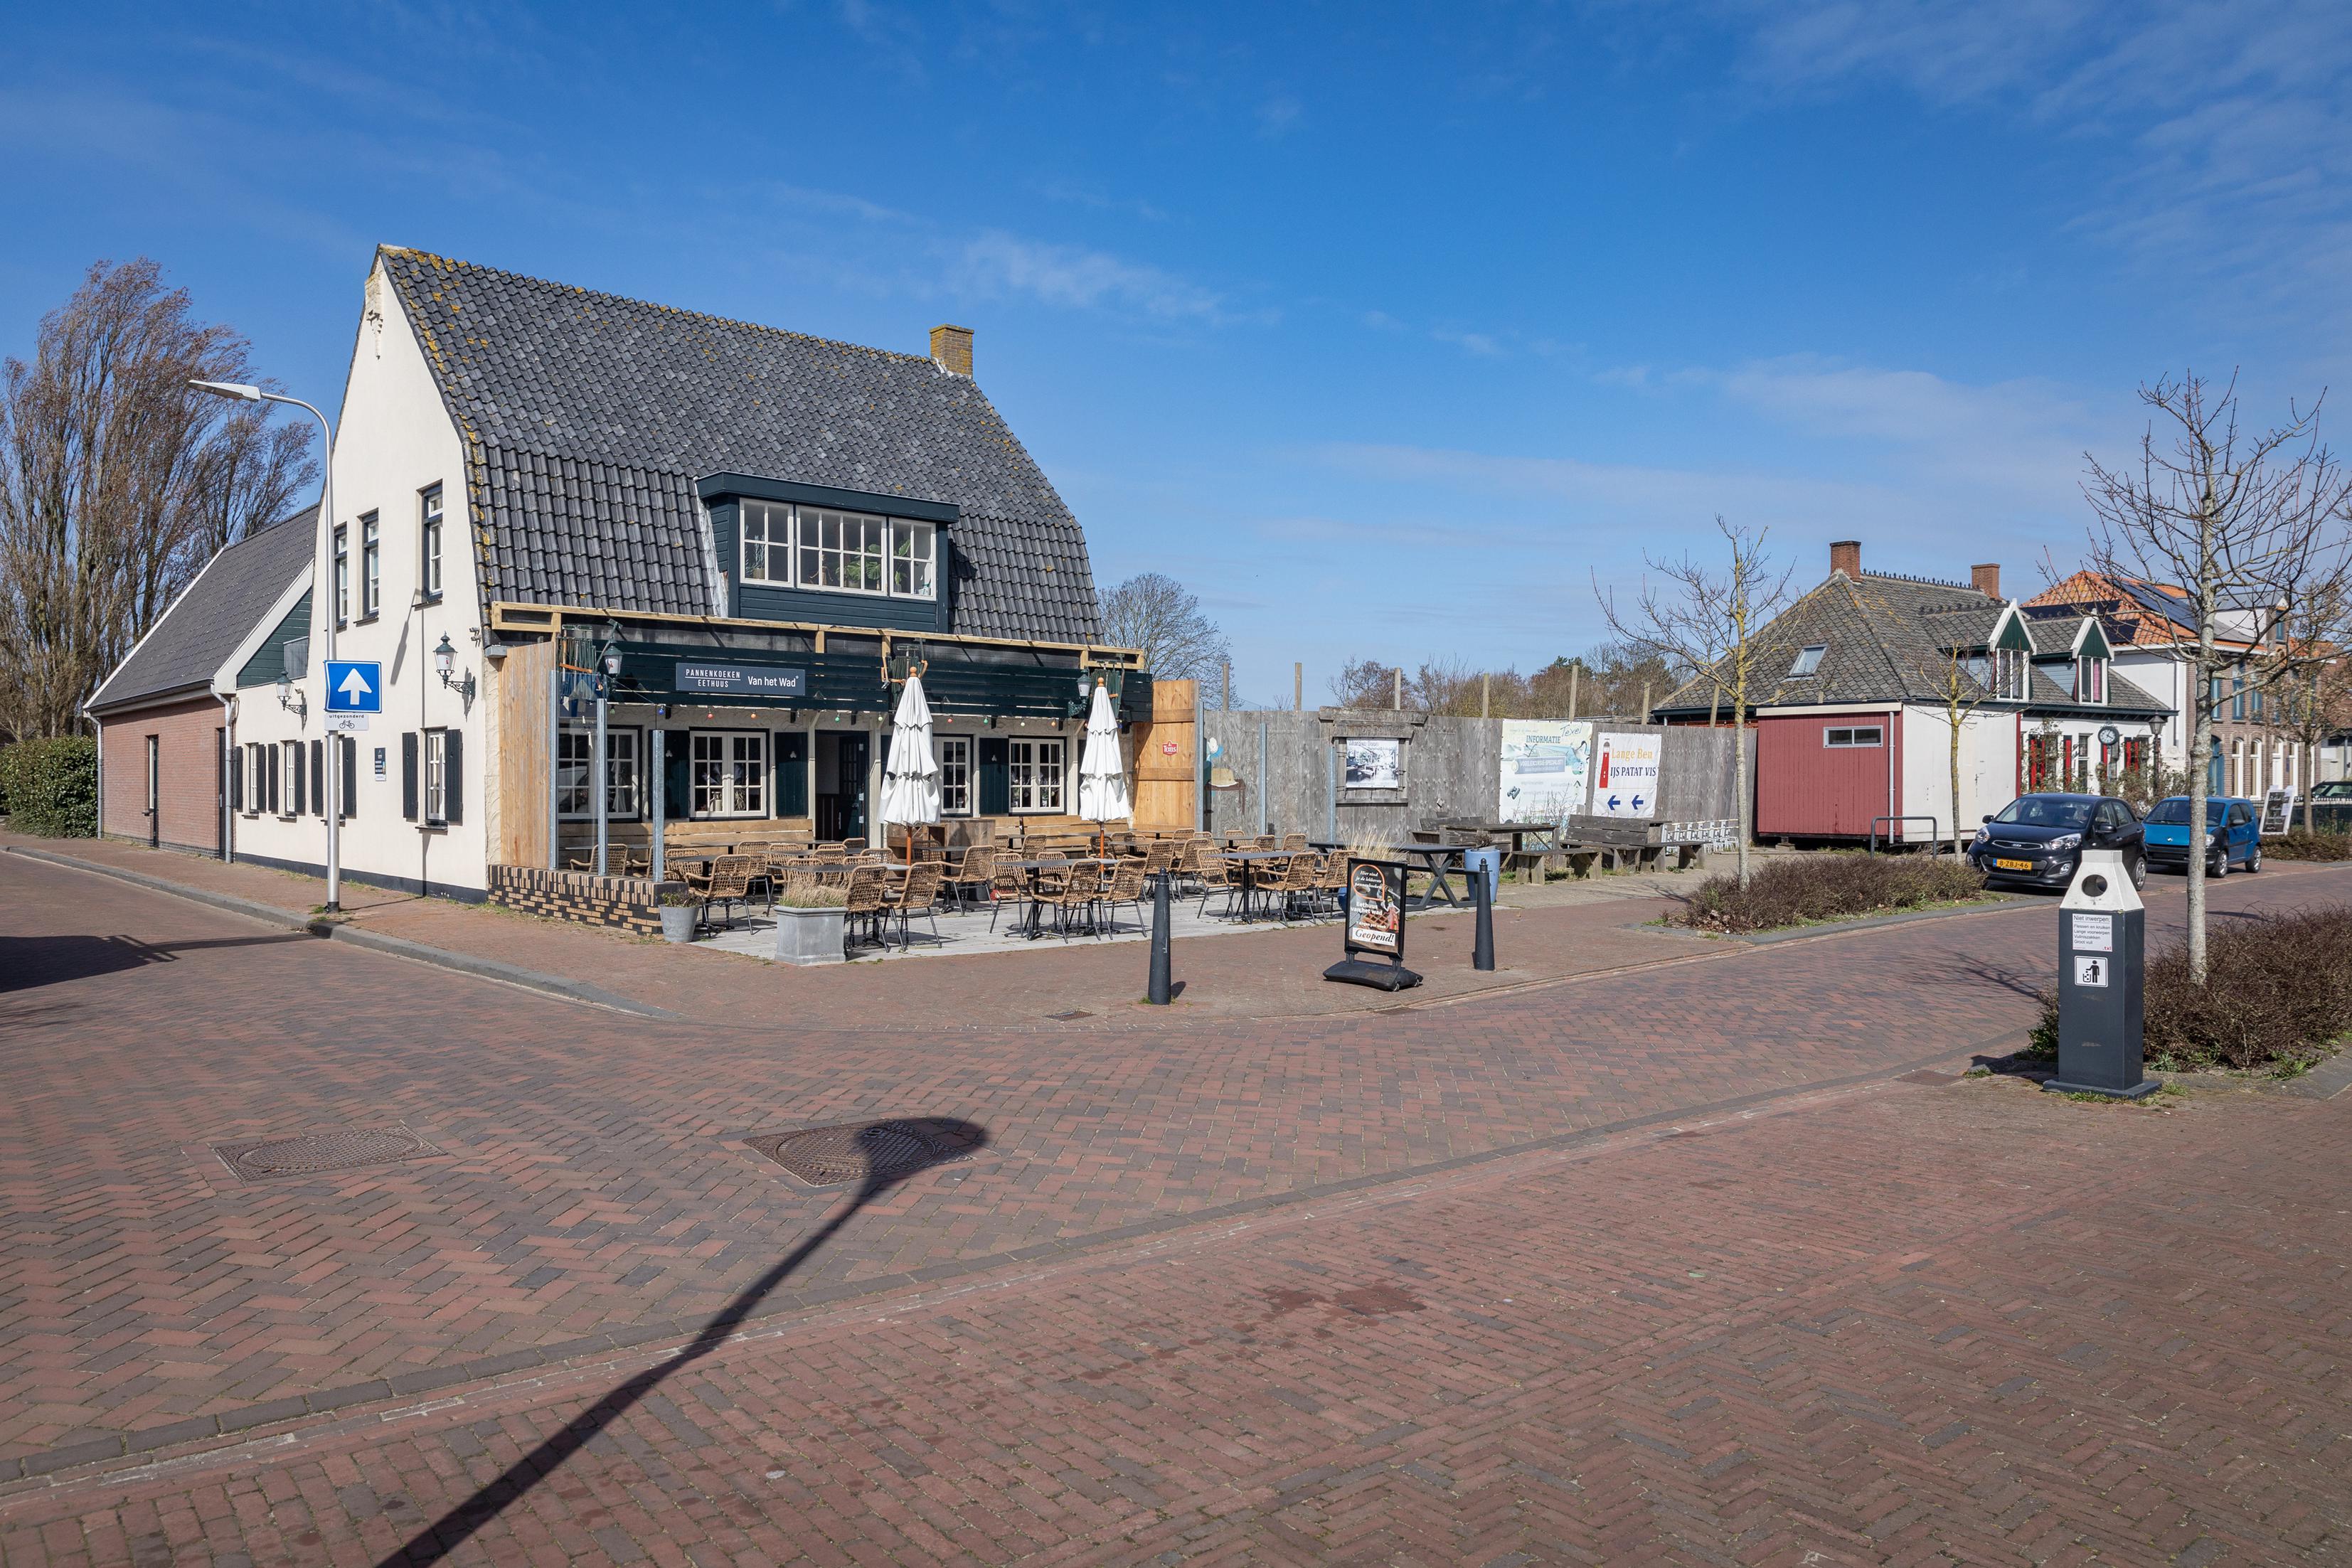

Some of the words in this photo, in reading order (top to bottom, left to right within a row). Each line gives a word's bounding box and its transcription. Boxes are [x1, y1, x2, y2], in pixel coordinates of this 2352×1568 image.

[686, 669, 740, 678] PANNENKOEKEN
[747, 676, 762, 686] Van
[765, 676, 777, 686] het
[1560, 722, 1584, 737] Texel
[1526, 735, 1561, 744] INFORMATIE
[1612, 748, 1635, 762] Lange
[1637, 748, 1653, 759] Ben
[1610, 767, 1619, 778] IJS
[1622, 767, 1643, 777] PATAT
[1645, 767, 1656, 777] VIS
[1355, 929, 1395, 943] Geopend!
